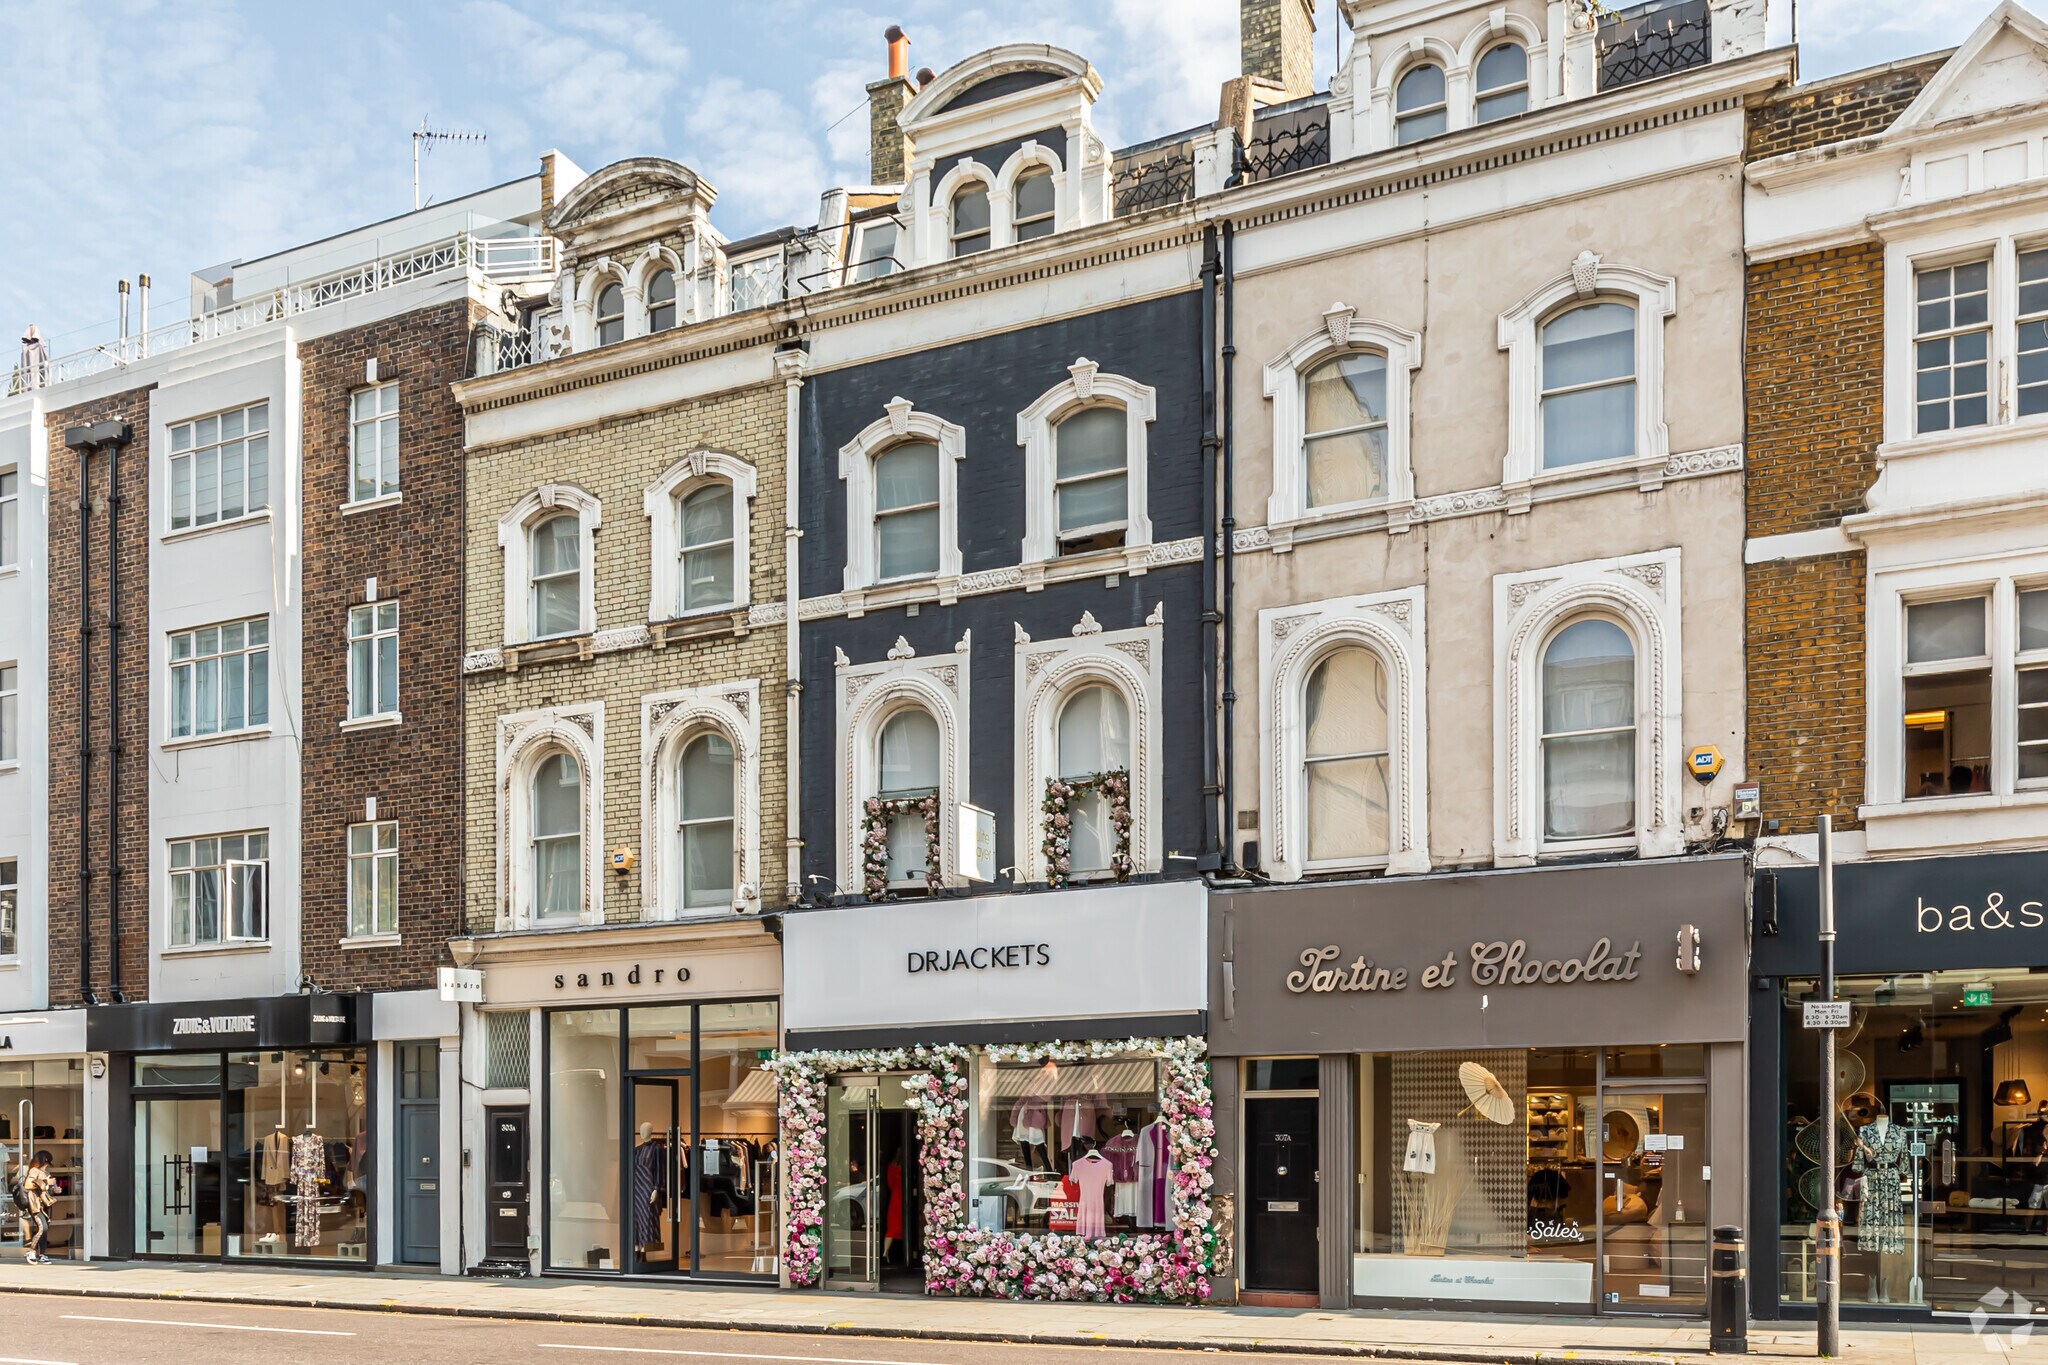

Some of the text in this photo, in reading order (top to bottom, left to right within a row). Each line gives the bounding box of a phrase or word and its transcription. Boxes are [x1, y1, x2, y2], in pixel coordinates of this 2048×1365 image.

[1695, 754, 1712, 764] ADT
[1917, 892, 2044, 933] ba&s
[907, 943, 1050, 973] DRJACKETS
[1286, 937, 1642, 993] Tartine et Chocolat
[444, 982, 480, 990] sandro
[554, 964, 691, 990] sandro
[173, 1015, 256, 1035] ZADIG&VOLTAIRE
[1050, 1208, 1079, 1220] SAL
[1530, 1220, 1582, 1240] Sales
